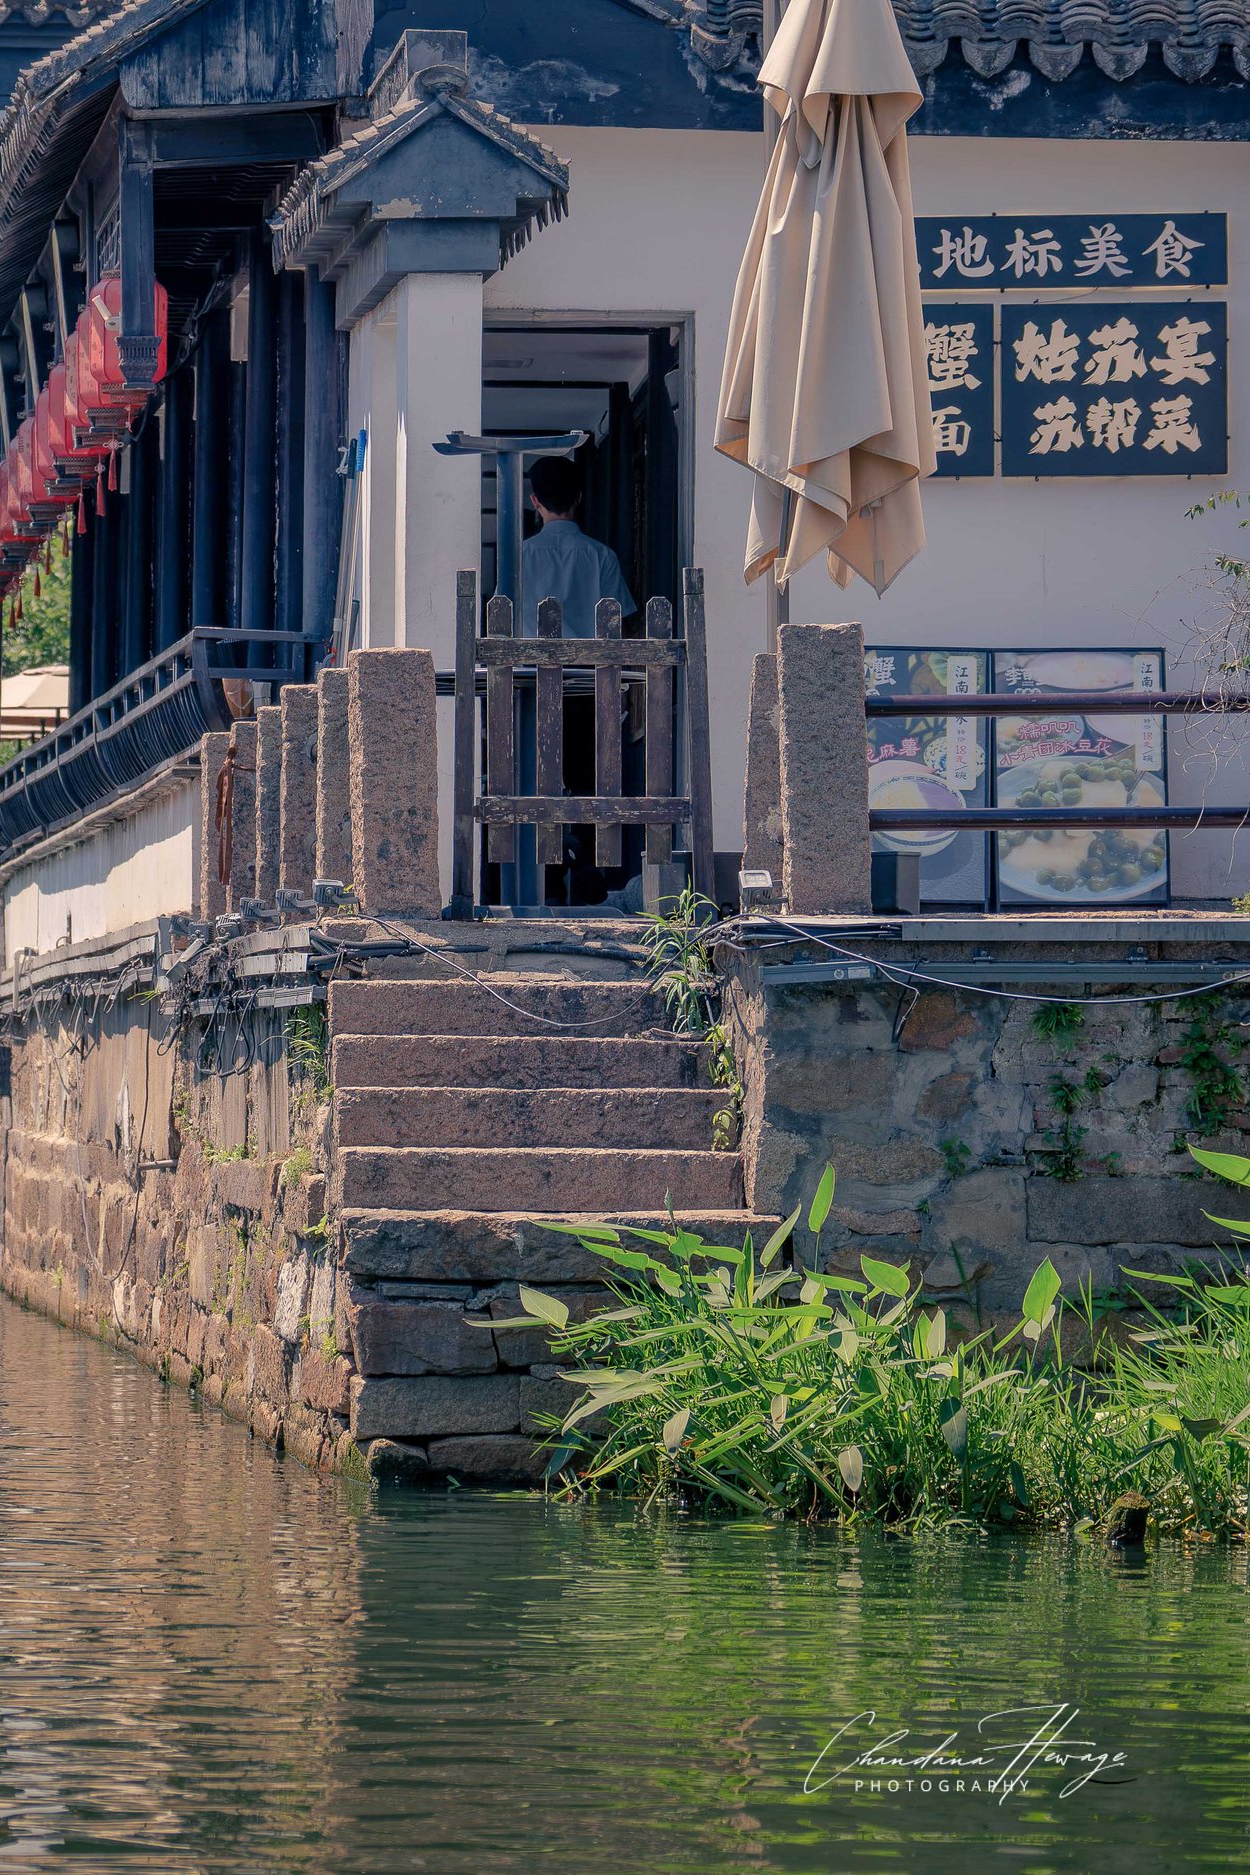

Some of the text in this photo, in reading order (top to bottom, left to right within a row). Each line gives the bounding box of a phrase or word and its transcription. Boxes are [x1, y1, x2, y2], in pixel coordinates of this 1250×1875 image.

[917, 220, 1205, 278] 地标美食
[1012, 316, 1216, 386] 姑苏宴
[1028, 394, 1202, 455] 苏帮菜
[1142, 663, 1153, 694] 江南
